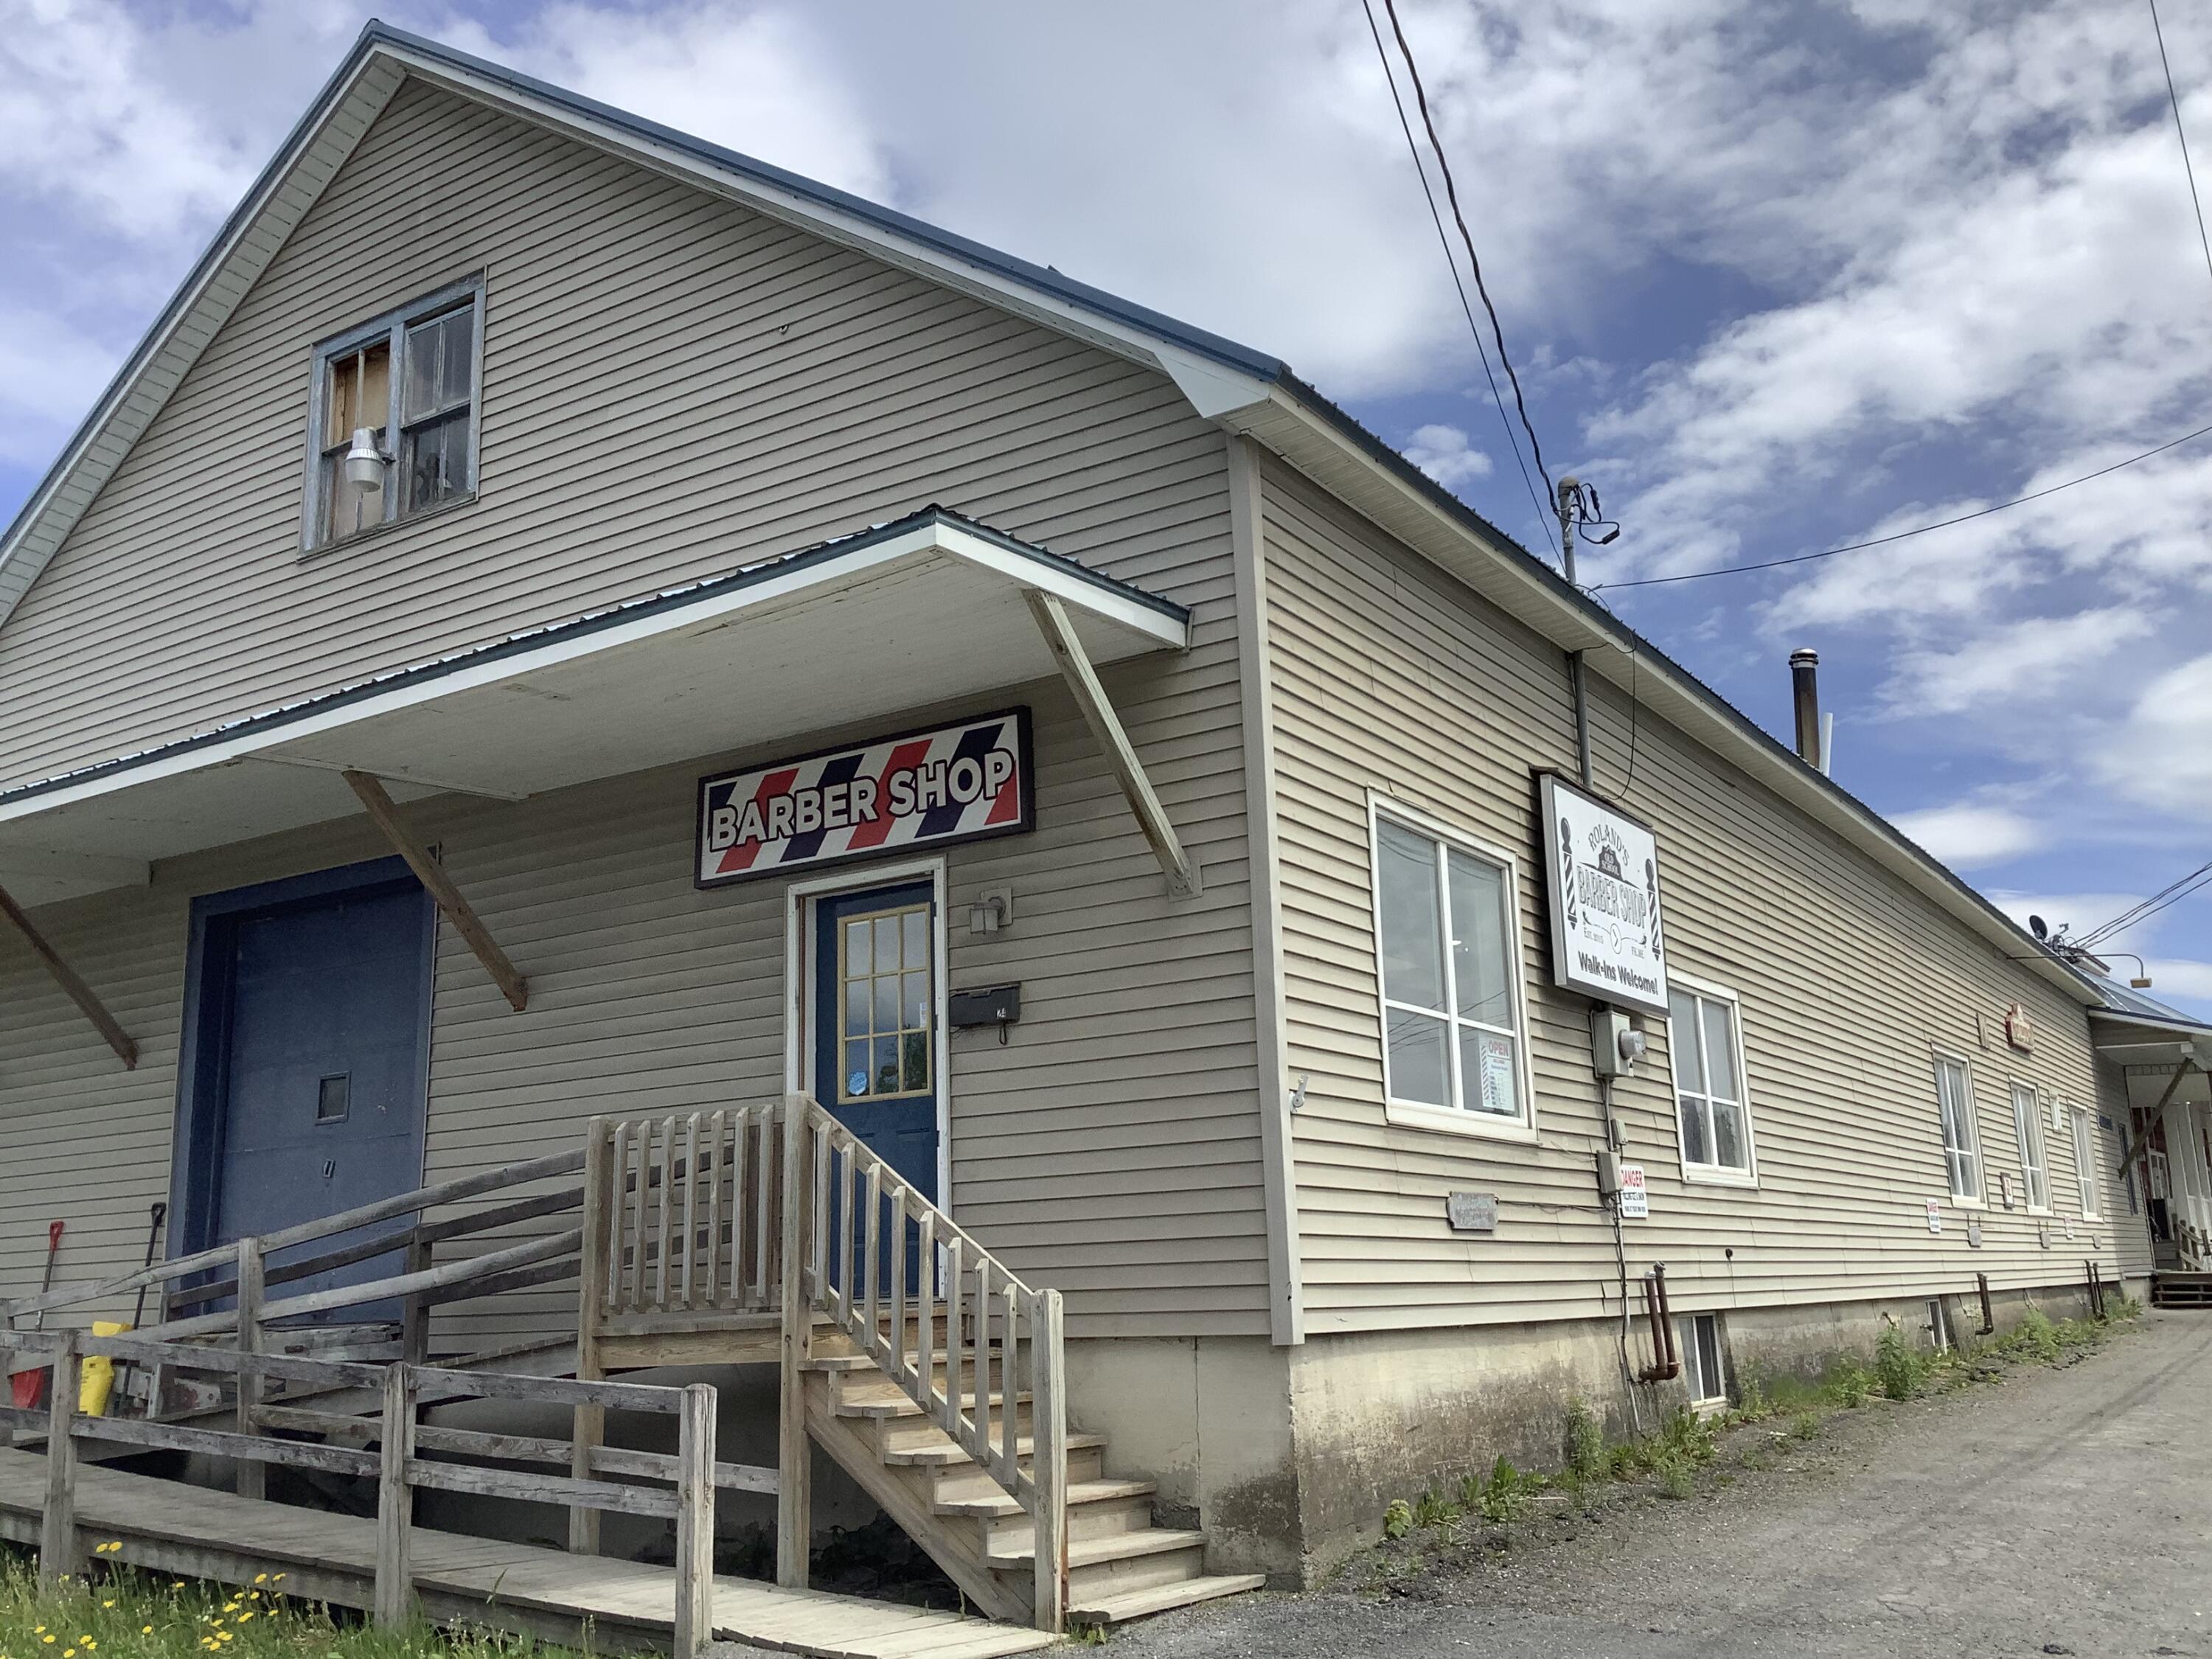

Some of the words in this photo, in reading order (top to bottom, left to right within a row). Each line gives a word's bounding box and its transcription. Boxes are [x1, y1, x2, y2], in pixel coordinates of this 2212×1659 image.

[711, 776, 880, 851] BARBER
[888, 748, 1015, 818] SHOP
[1587, 824, 1630, 867] ROLAND'S
[1576, 865, 1620, 919] BARBER
[1619, 884, 1647, 930] SHOP
[1578, 950, 1617, 982] Walk-Ins
[1618, 966, 1659, 996] Welcome!
[1488, 1040, 1509, 1057] OPEN
